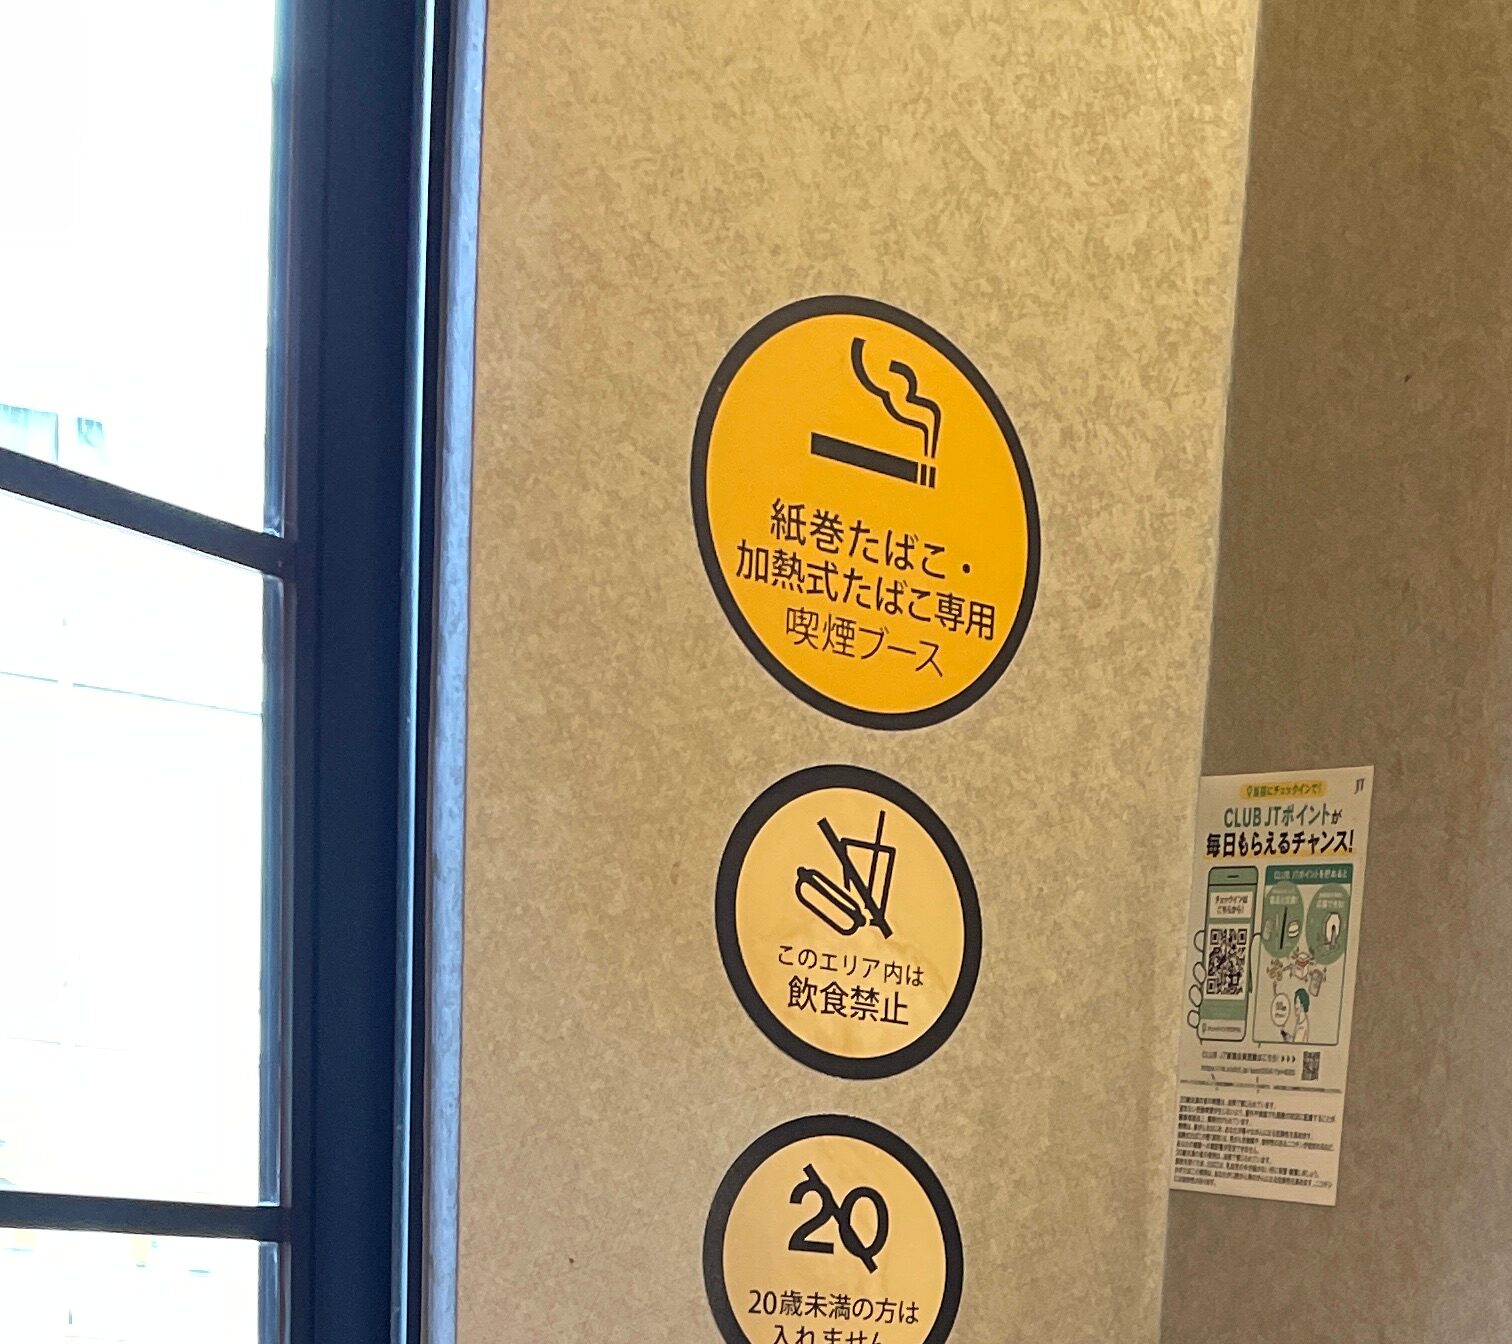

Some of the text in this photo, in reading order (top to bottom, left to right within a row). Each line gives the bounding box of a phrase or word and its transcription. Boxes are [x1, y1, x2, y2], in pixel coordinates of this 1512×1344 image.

[735, 538, 995, 641] 加熱式たばこ専用
[785, 606, 943, 678] 喫煙ブース
[1224, 803, 1343, 828] CLUB JTポイントが
[1205, 829, 1355, 858] 毎日もらえるチャンス!
[777, 944, 925, 988] このエリア内は
[786, 975, 909, 1027] 飲食禁止
[788, 1177, 889, 1263] 20
[748, 1289, 919, 1329] 20歳未満の方は
